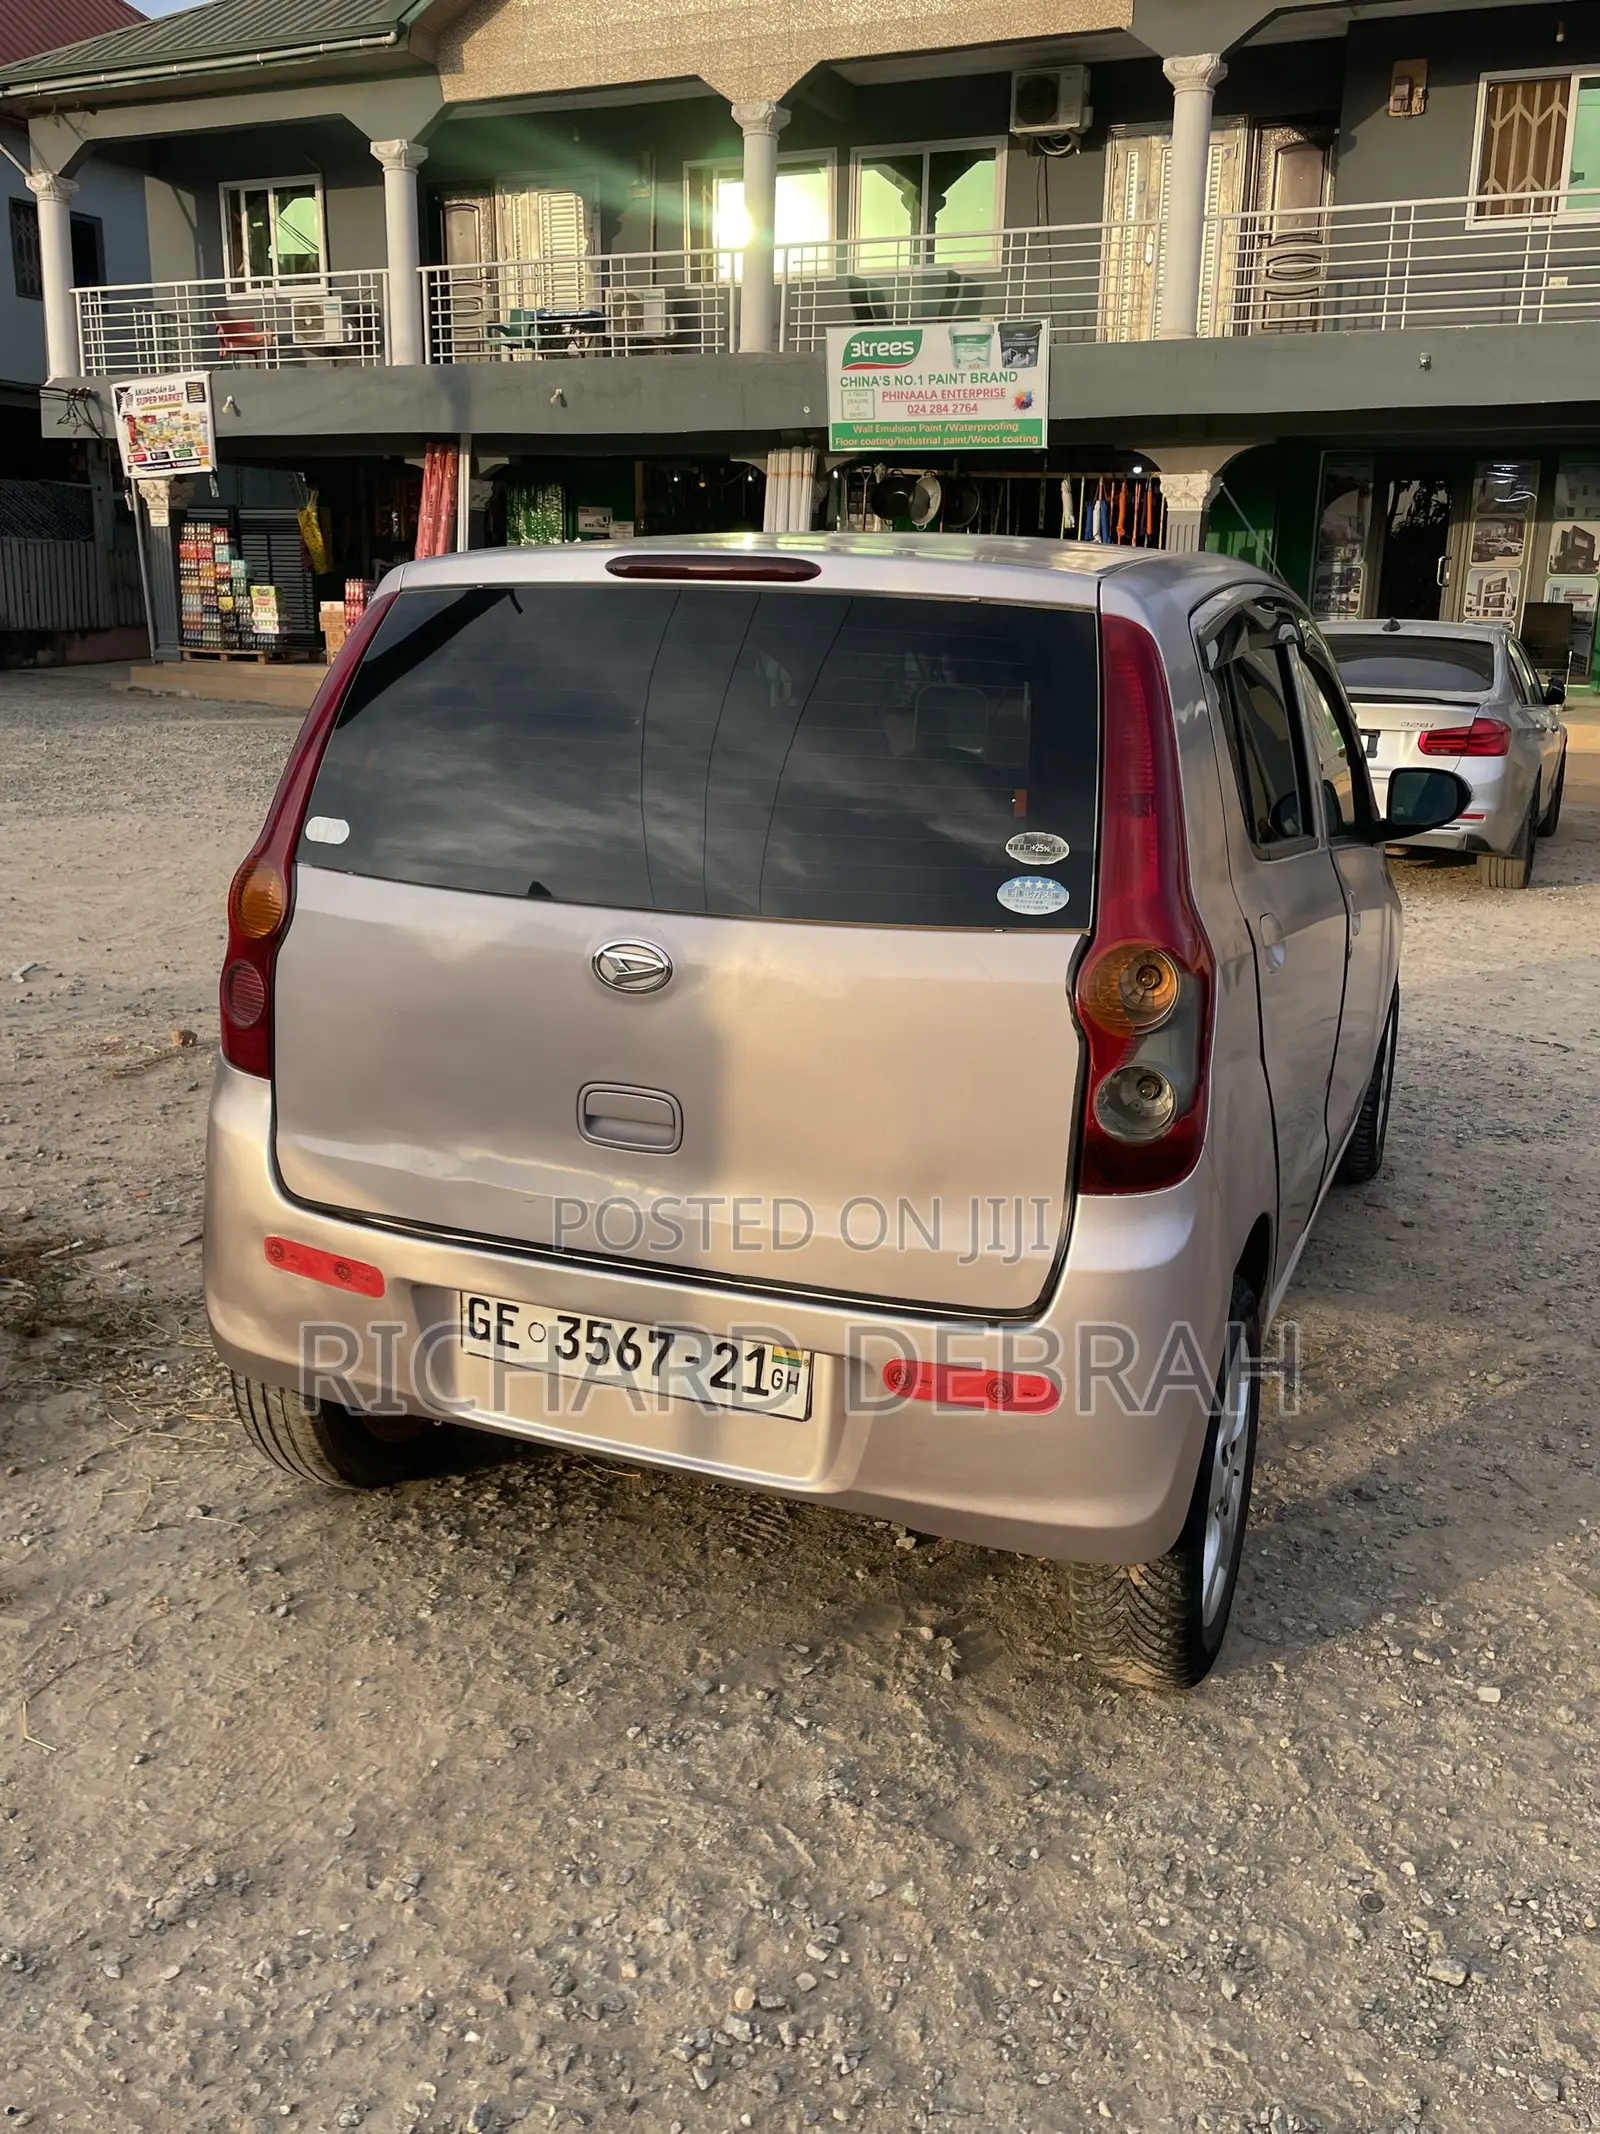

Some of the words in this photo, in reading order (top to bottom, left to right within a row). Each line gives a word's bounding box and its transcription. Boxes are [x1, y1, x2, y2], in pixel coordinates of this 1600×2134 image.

[850, 340, 915, 358] 3trees
[840, 375, 891, 388] CHINA'S
[894, 374, 923, 386] NO.1
[928, 373, 967, 385] PAINT
[970, 371, 1018, 384] BRAND
[136, 395, 157, 406] SUPER
[158, 392, 184, 403] MARKET
[882, 390, 937, 401] PHINAALA
[941, 387, 1006, 399] ENTERPRISE
[907, 404, 926, 414] 024
[929, 404, 948, 413] 284
[952, 403, 978, 413] 2764
[853, 424, 873, 433] Wall
[875, 424, 916, 433] Emulsion
[919, 423, 942, 432] Paint
[835, 437, 857, 446] Floor
[943, 434, 1000, 446] paint/Wood
[1002, 434, 1038, 445] coating
[467, 1297, 520, 1349] GE
[555, 1315, 770, 1397] 3567-21
[770, 1368, 800, 1395] GH
